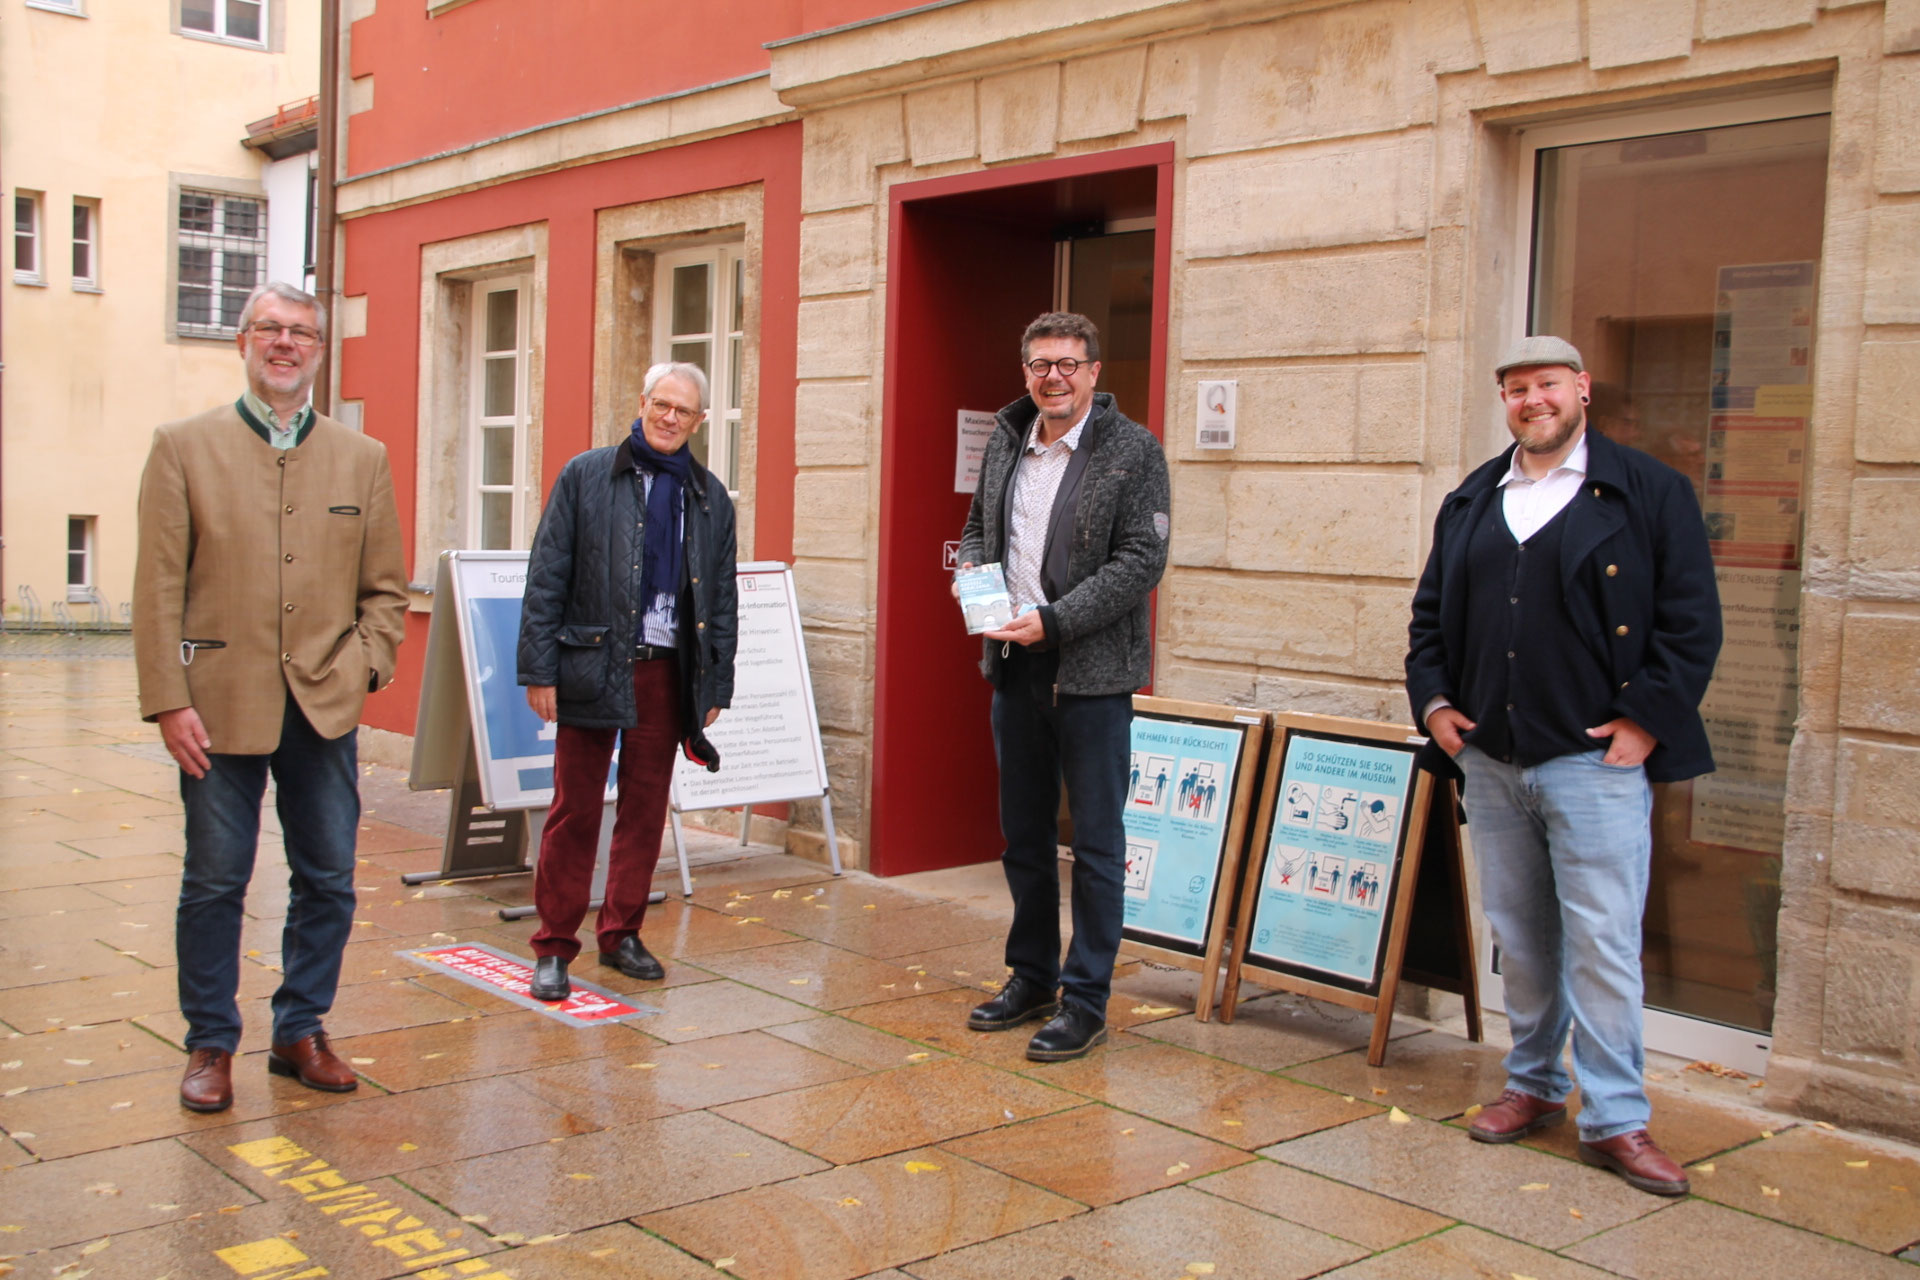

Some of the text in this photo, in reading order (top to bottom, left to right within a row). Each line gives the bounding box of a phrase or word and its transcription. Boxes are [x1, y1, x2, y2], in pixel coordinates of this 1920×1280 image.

[964, 417, 995, 426] Maximale
[490, 572, 527, 584] Touris
[738, 601, 787, 609] st-Information
[1777, 608, 1795, 616] und
[1136, 732, 1228, 752] NEHMEN SIE RÜCKSICHT!
[1302, 752, 1392, 773] SO SCHÜTZEN SIE SICH
[1295, 760, 1396, 785] UND ANDERE IM MUSEUM
[437, 953, 467, 965] SIE
[455, 949, 534, 980] BITTE HAL
[262, 1152, 503, 1280] HERMEN
